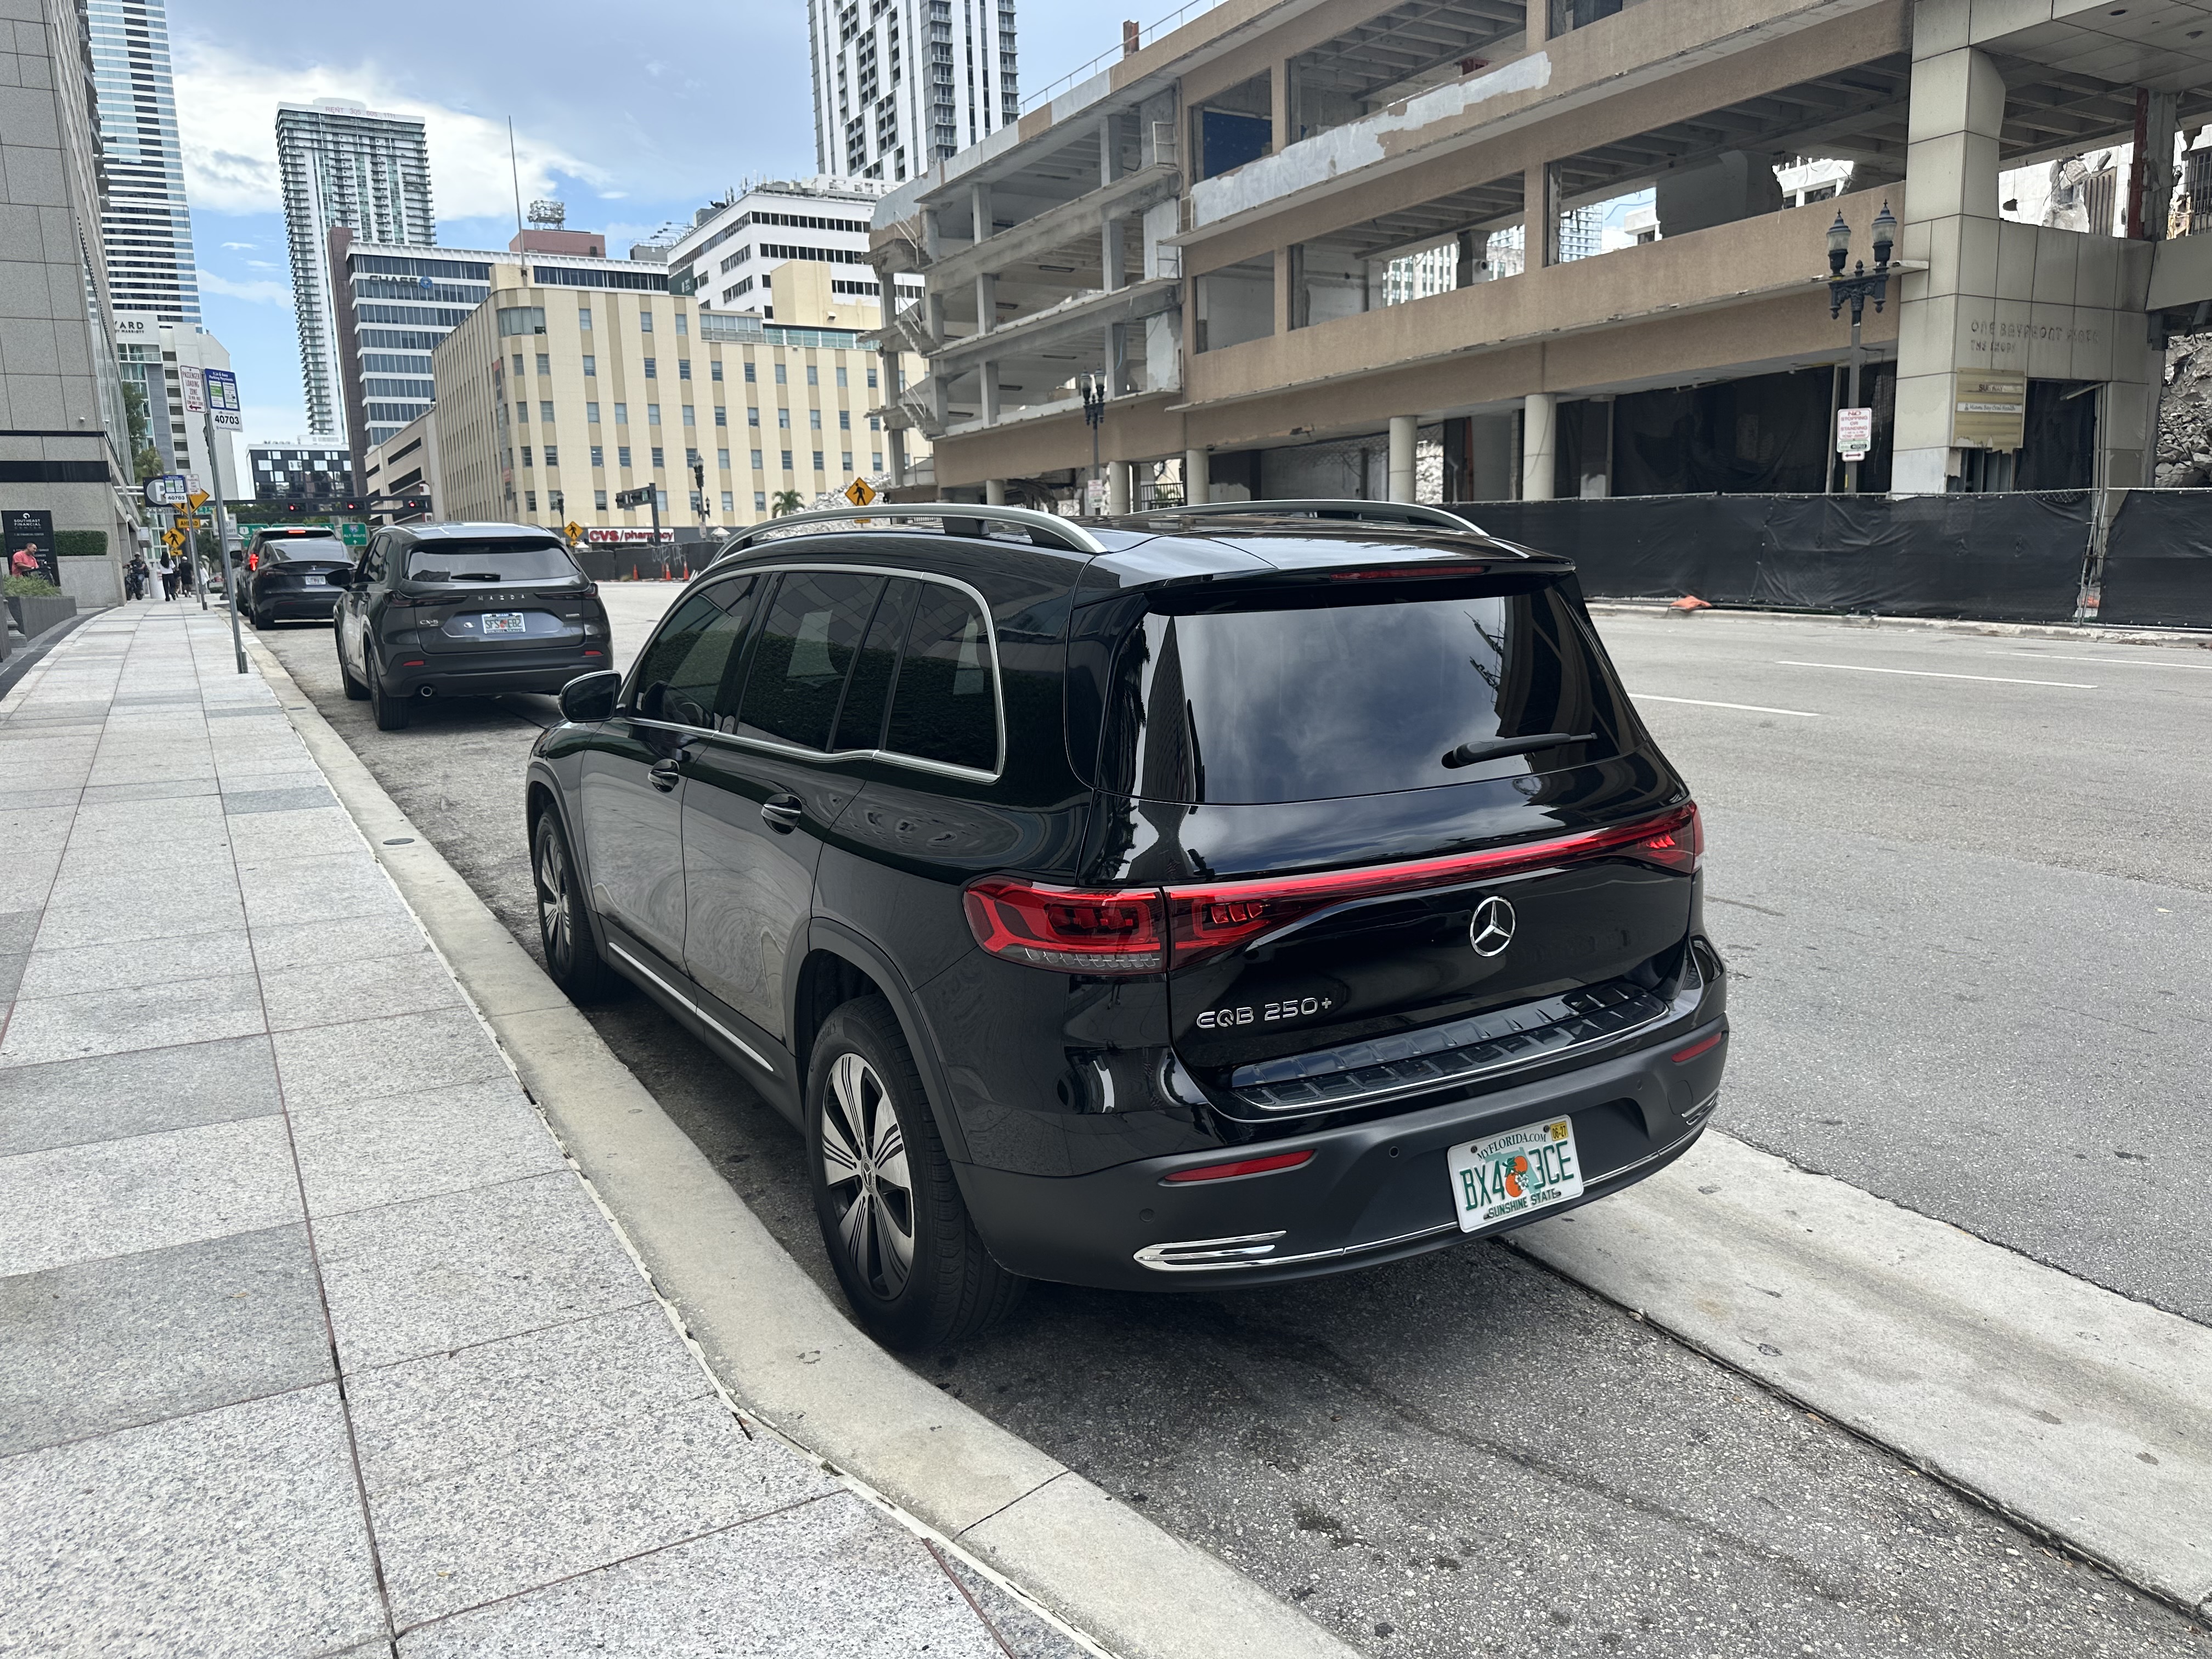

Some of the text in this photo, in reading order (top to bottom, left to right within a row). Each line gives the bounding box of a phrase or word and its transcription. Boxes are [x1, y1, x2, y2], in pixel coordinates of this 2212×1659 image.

[370, 275, 417, 287] CHASE
[182, 371, 200, 380] PASSENGER
[185, 380, 199, 388] LOADING
[215, 415, 239, 425] 40703
[485, 619, 500, 629] SFS
[1197, 997, 1332, 1029] EQB 250+
[1477, 1133, 1547, 1161] MYFLORIDA.COM
[1487, 1188, 1556, 1218] SUNSHINE STATE
